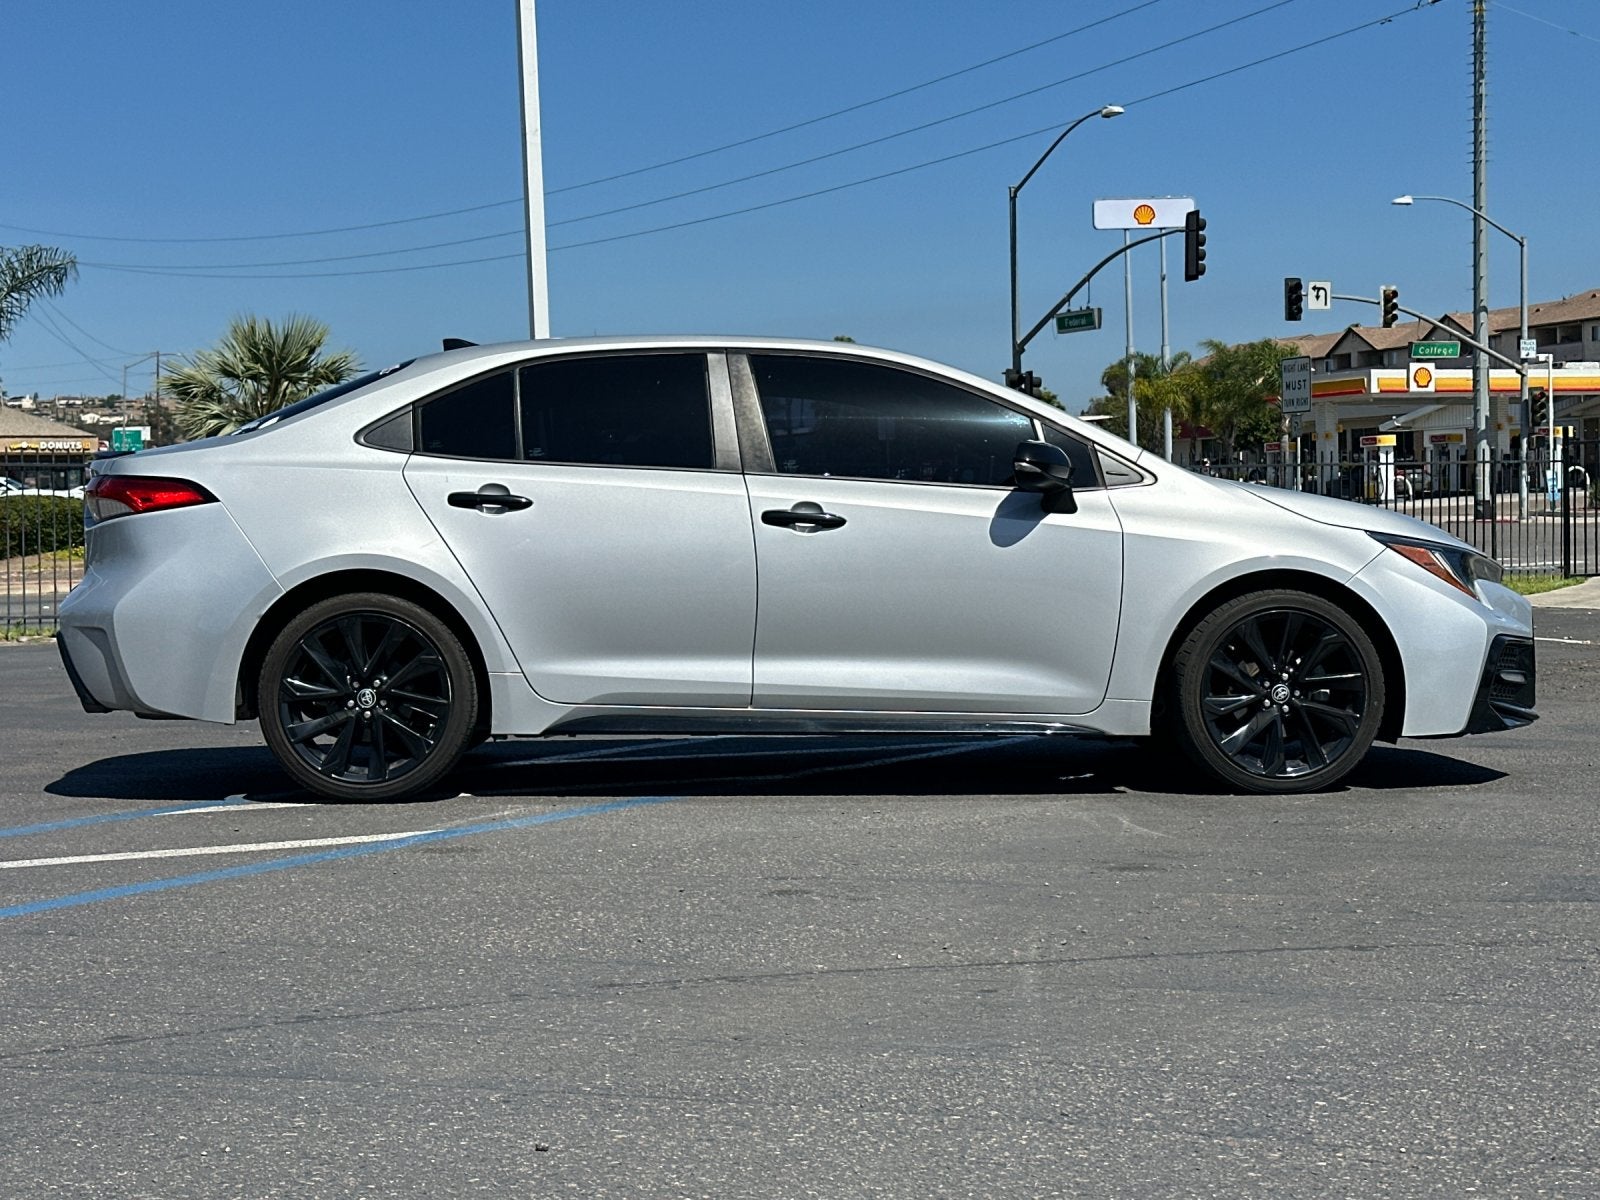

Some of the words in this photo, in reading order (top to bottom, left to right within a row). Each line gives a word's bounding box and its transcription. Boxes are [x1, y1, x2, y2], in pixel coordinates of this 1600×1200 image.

[1418, 346, 1453, 356] College
[1297, 362, 1309, 372] LANE
[1285, 379, 1307, 391] MUST
[39, 441, 83, 450] DONUTS
